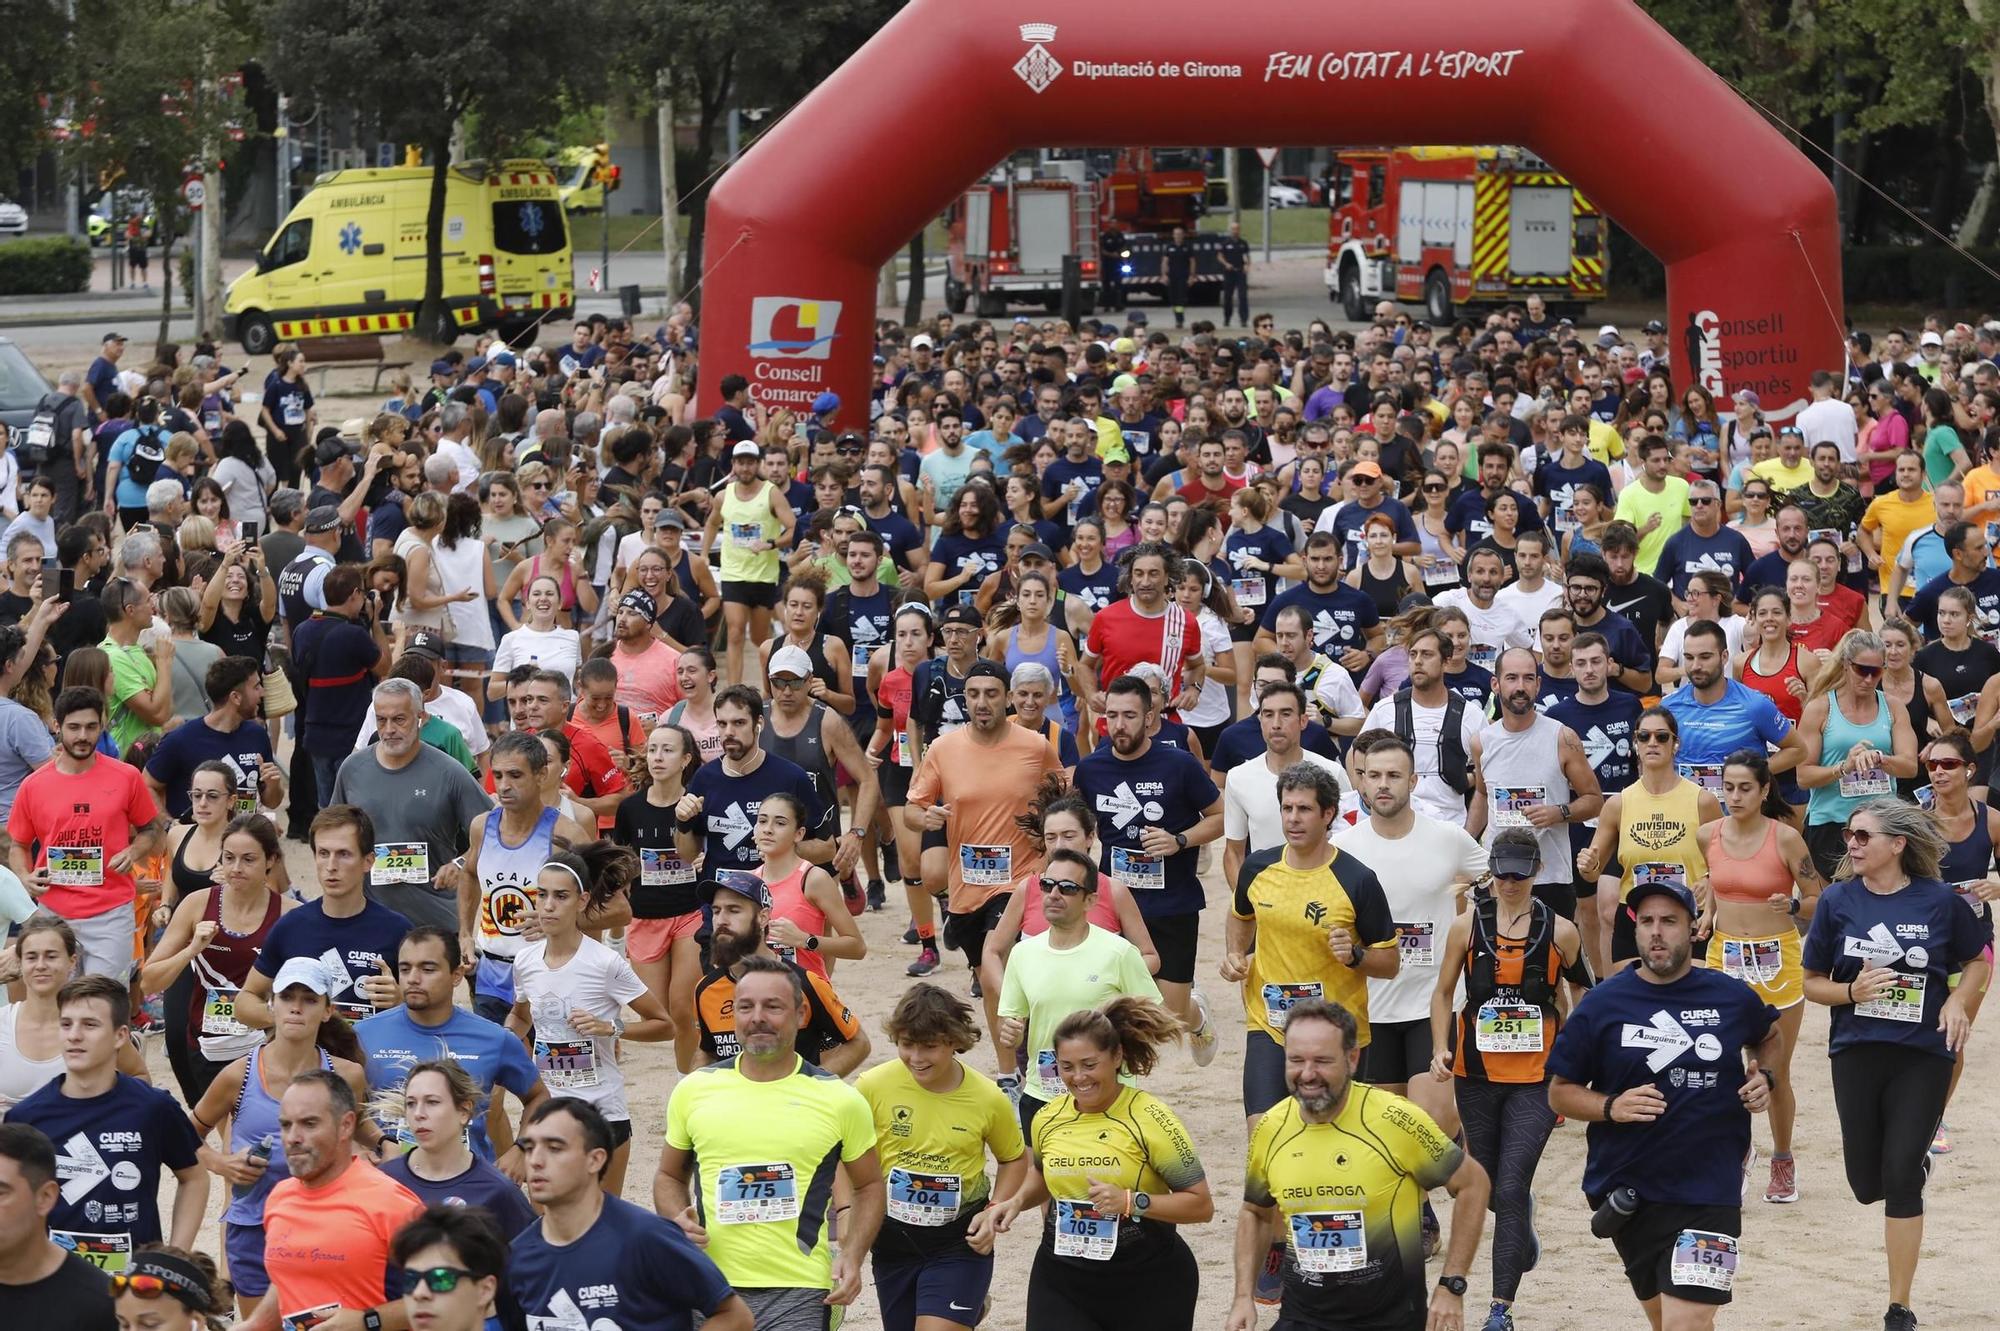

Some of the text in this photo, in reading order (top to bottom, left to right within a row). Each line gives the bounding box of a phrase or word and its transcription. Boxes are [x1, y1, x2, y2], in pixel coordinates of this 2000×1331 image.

[1073, 60, 1242, 80] Diputació de Girona
[1264, 49, 1524, 82] FEM COSTAT A L'ESPORT
[188, 187, 203, 199] 30
[754, 361, 822, 383] Consell
[747, 382, 831, 403] Comarc
[1135, 782, 1164, 790] CURSA
[638, 827, 678, 838] NIK
[1636, 822, 1680, 831] DIVISION
[80, 828, 91, 840] EL
[62, 860, 88, 870] 258
[387, 857, 412, 867] 224
[656, 861, 681, 870] 160
[971, 859, 996, 869] 719
[1125, 862, 1150, 873] 792
[1896, 924, 1929, 933] CURSA
[1401, 936, 1419, 948] 70
[1849, 941, 1890, 955] Apaguem
[348, 950, 383, 961] CURSA
[1880, 988, 1906, 1000] 09
[1680, 1009, 1720, 1020] CURSA
[1494, 1021, 1522, 1032] 251
[1631, 1029, 1677, 1044] Apaguem
[717, 1045, 741, 1057] GIRO
[548, 1057, 575, 1069] 111
[1144, 1106, 1172, 1136] CALELLA
[1381, 1112, 1416, 1138] CALELLA
[1150, 1104, 1195, 1164] CREU GROGA
[1387, 1105, 1445, 1157] CREU GROGA
[99, 1132, 142, 1144] CURSA
[1049, 1156, 1121, 1167] CREU GROGA
[56, 1163, 92, 1174] paguem
[737, 1183, 776, 1199] 775
[1283, 1186, 1366, 1200] CREU GROGA
[906, 1189, 940, 1206] 704
[1069, 1219, 1097, 1236] 705
[1308, 1232, 1343, 1248] 773
[80, 1254, 109, 1270] 07
[1691, 1249, 1724, 1267] 154
[578, 1284, 618, 1300] CURSA
